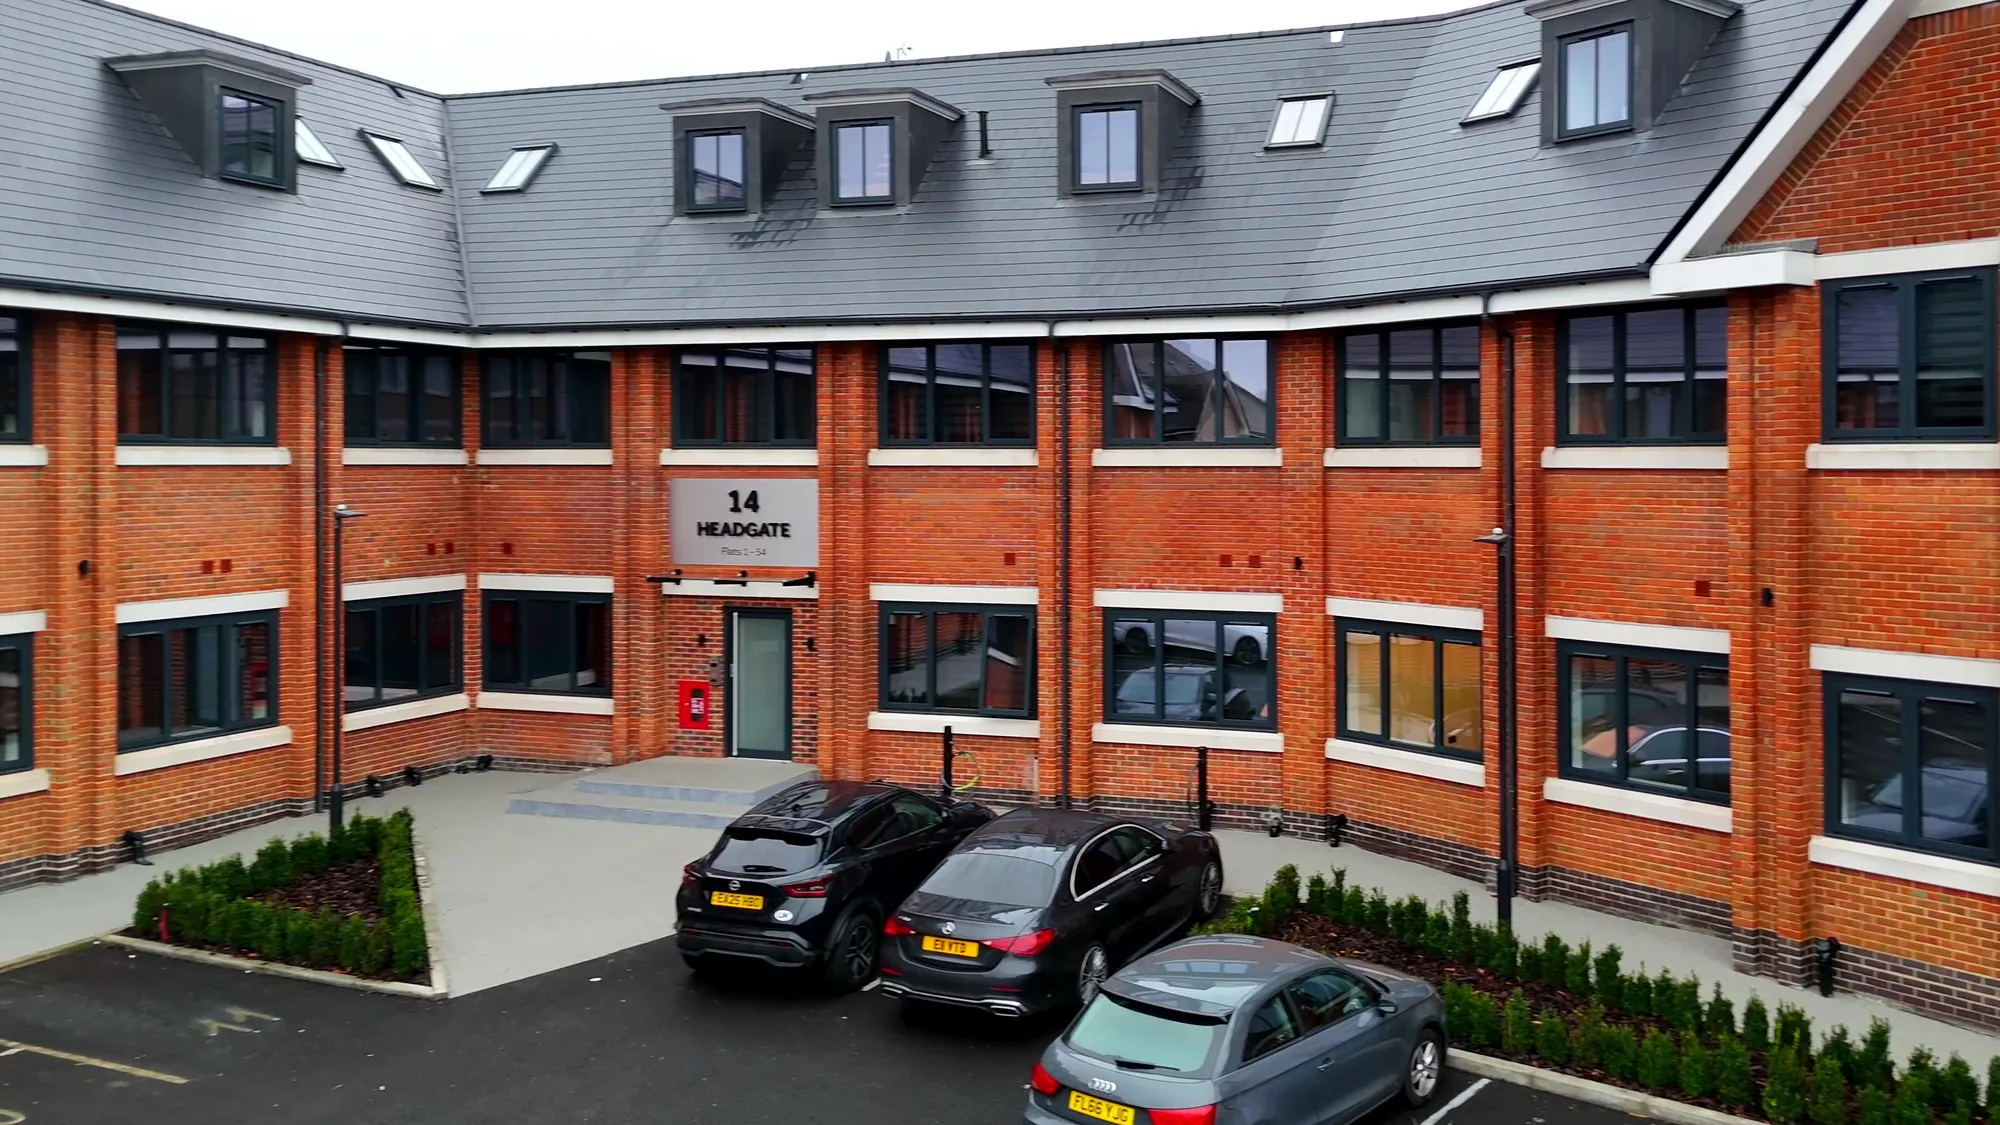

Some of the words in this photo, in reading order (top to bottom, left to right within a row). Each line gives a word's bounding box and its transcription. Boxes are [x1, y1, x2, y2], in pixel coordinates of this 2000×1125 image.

[728, 490, 760, 513] 14
[697, 521, 791, 538] HEADGATE
[721, 547, 742, 556] Flats
[1074, 1094, 1102, 1115] FL66
[1104, 1103, 1128, 1122] YJG
